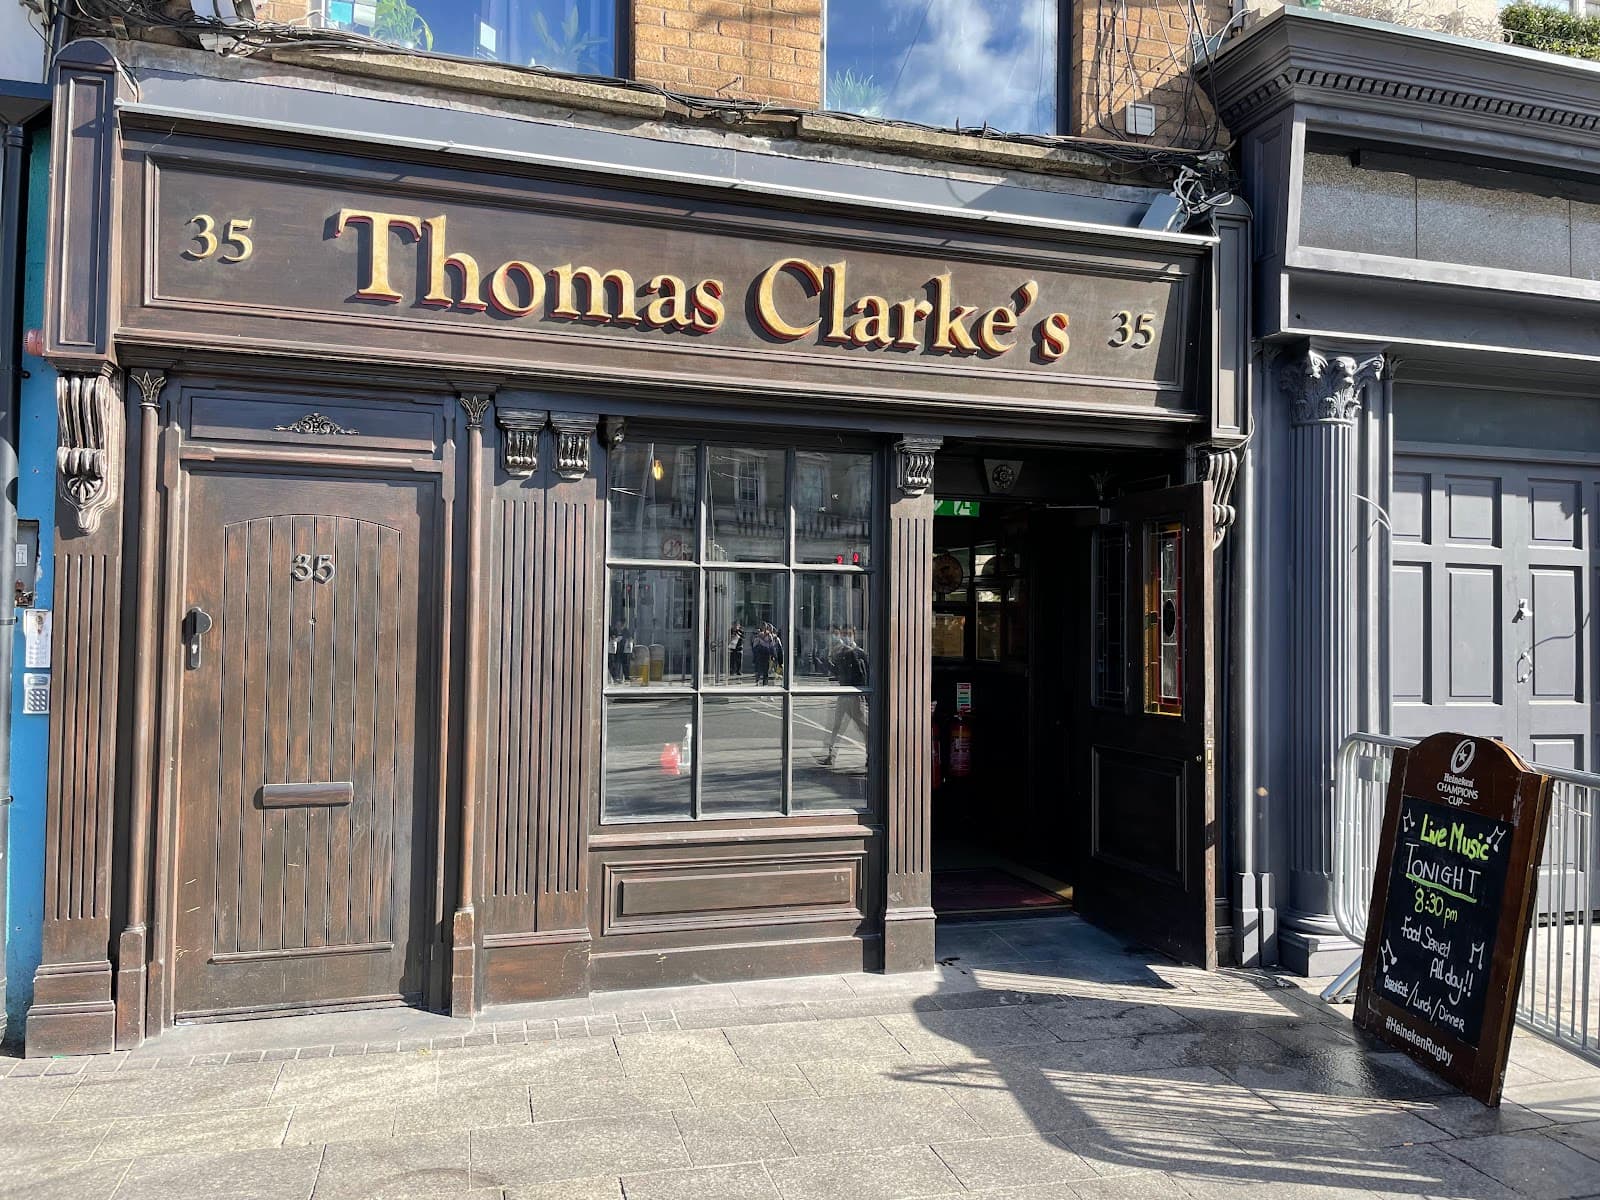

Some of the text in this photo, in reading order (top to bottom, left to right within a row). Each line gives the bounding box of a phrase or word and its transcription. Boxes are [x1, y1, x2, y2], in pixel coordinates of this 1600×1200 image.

[185, 214, 254, 263] 35
[335, 207, 1071, 362] Thomas Clarke's
[1108, 310, 1156, 348] 35
[291, 553, 335, 584] 35
[1436, 782, 1479, 800] CHAMPIONS
[1420, 813, 1490, 861] Live Music
[1405, 842, 1482, 894] TONIGHT
[1400, 915, 1422, 943] Food
[1414, 887, 1458, 929] 8:30 pm
[1429, 957, 1445, 980] All
[1385, 1015, 1454, 1067] #HeinekenRugby
